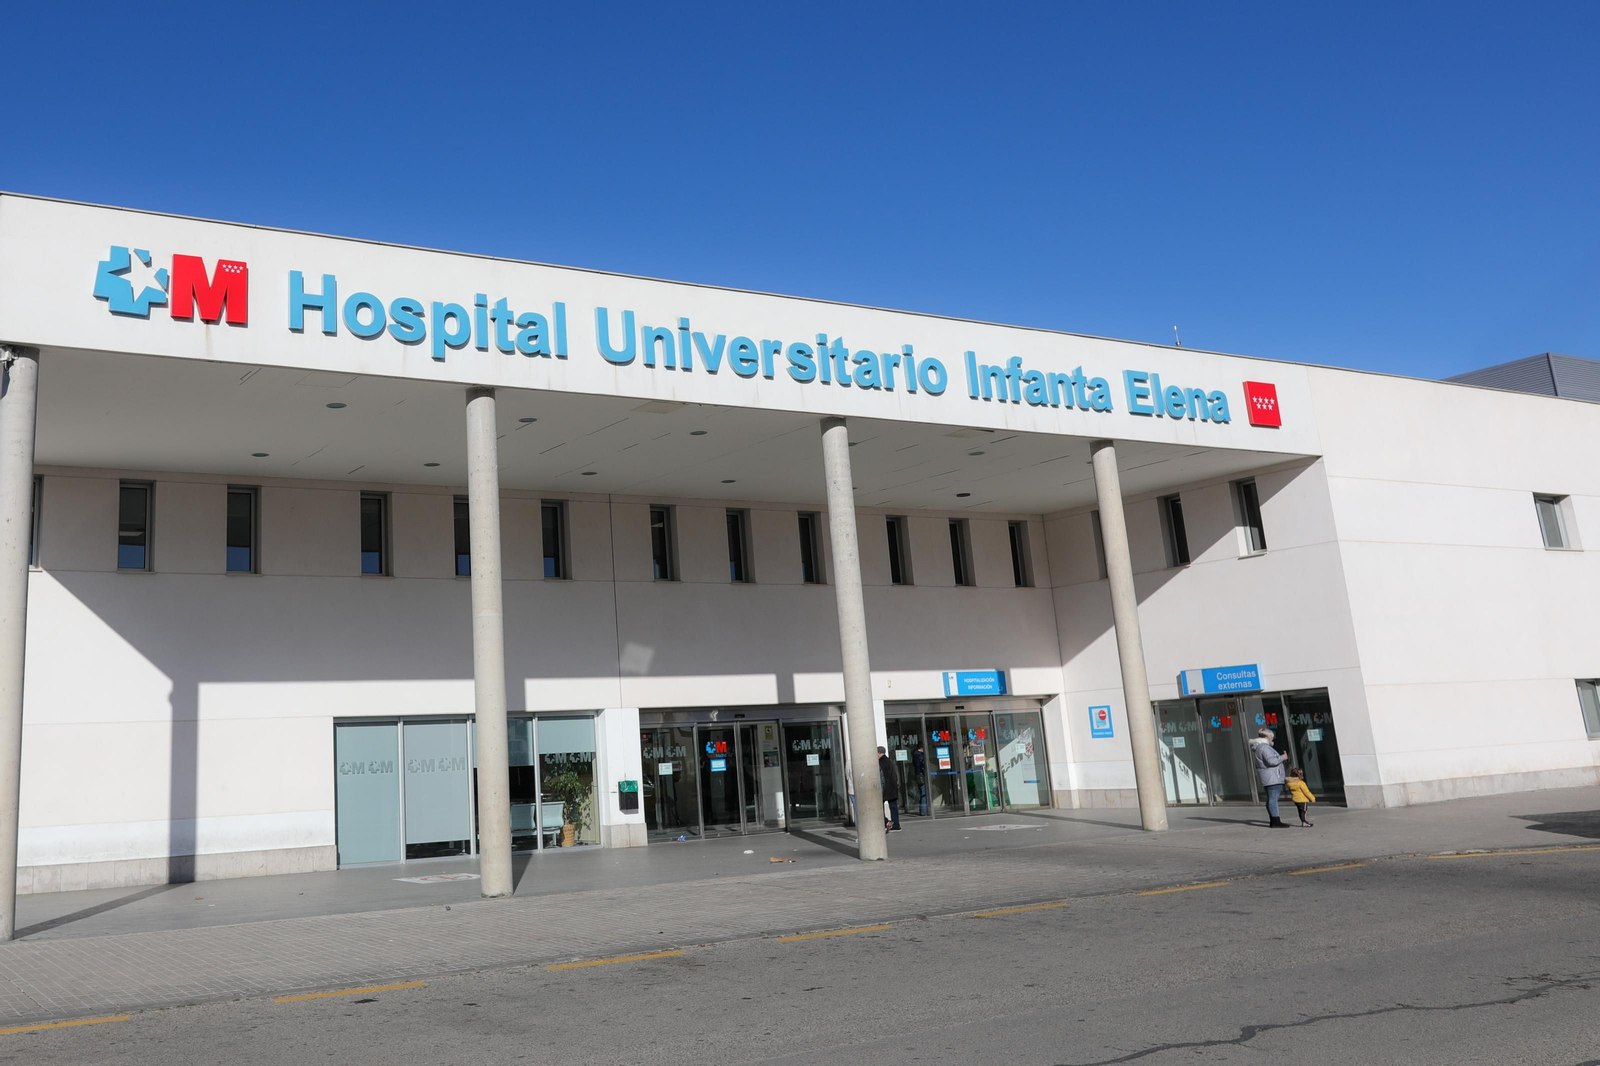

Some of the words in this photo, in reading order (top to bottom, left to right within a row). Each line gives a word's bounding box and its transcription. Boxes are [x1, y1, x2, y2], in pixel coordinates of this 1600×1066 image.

[172, 254, 248, 325] M
[289, 270, 567, 360] Hospital
[597, 308, 948, 395] Universitario
[968, 351, 1113, 412] Infanta
[1125, 370, 1231, 422] Elena
[1216, 670, 1257, 681] Consultas
[1218, 680, 1253, 690] externas
[1220, 715, 1232, 728] M
[1265, 712, 1278, 725] M
[1299, 713, 1312, 725] M
[1167, 721, 1177, 732] M
[890, 735, 900, 746] M
[909, 734, 918, 745] M
[940, 730, 951, 742] M
[976, 728, 987, 740] M
[715, 741, 728, 753] M
[801, 739, 811, 750] M
[820, 738, 831, 749] M
[556, 752, 567, 763] M
[580, 752, 592, 763] M
[653, 747, 664, 758] M
[675, 746, 686, 757] M
[352, 761, 365, 775] M
[380, 760, 394, 773] M
[421, 758, 436, 773] M
[452, 756, 466, 771] M
